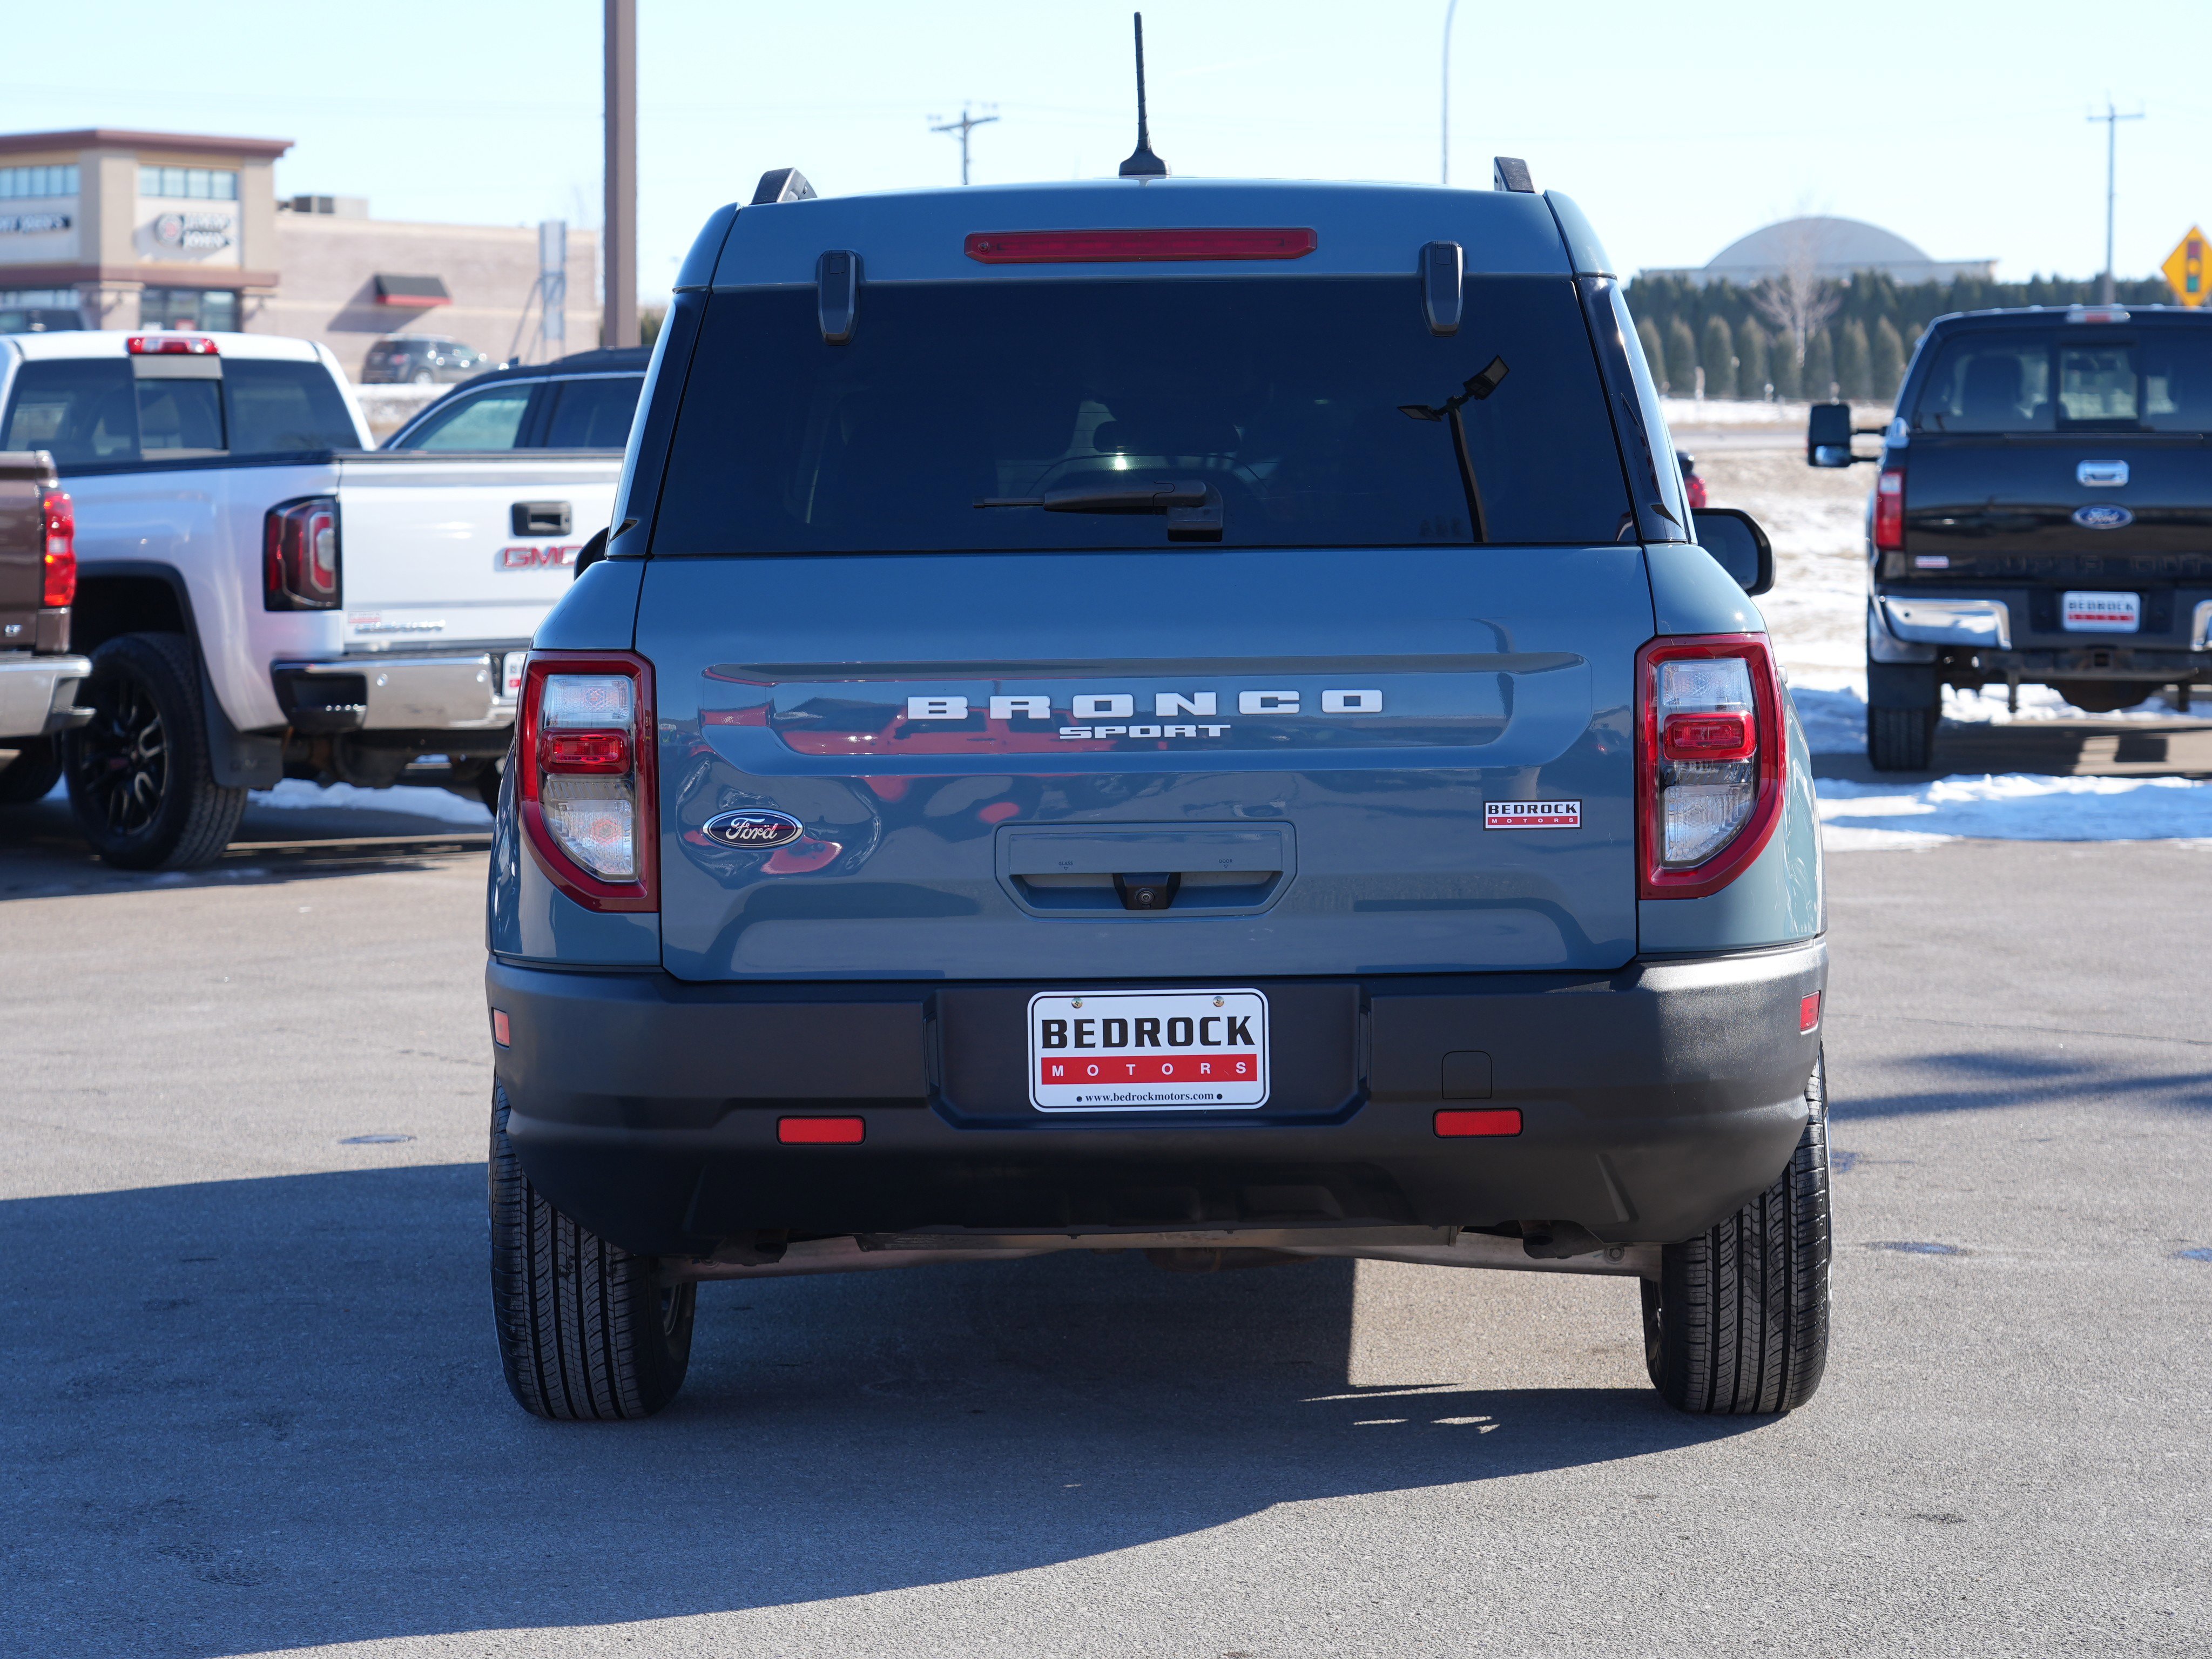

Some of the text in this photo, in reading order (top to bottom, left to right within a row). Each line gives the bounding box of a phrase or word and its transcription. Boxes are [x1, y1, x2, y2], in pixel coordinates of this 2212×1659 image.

[504, 545, 583, 568] GMC
[907, 689, 1382, 720] BRONCO
[1059, 724, 1231, 740] SPORT
[1488, 804, 1577, 814] BEDROCK
[725, 817, 779, 839] Ford
[1041, 1016, 1256, 1049] BEDROCK
[1051, 1062, 1247, 1077] MOTORS
[1085, 1091, 1215, 1102] www.bedrockmotors.com
